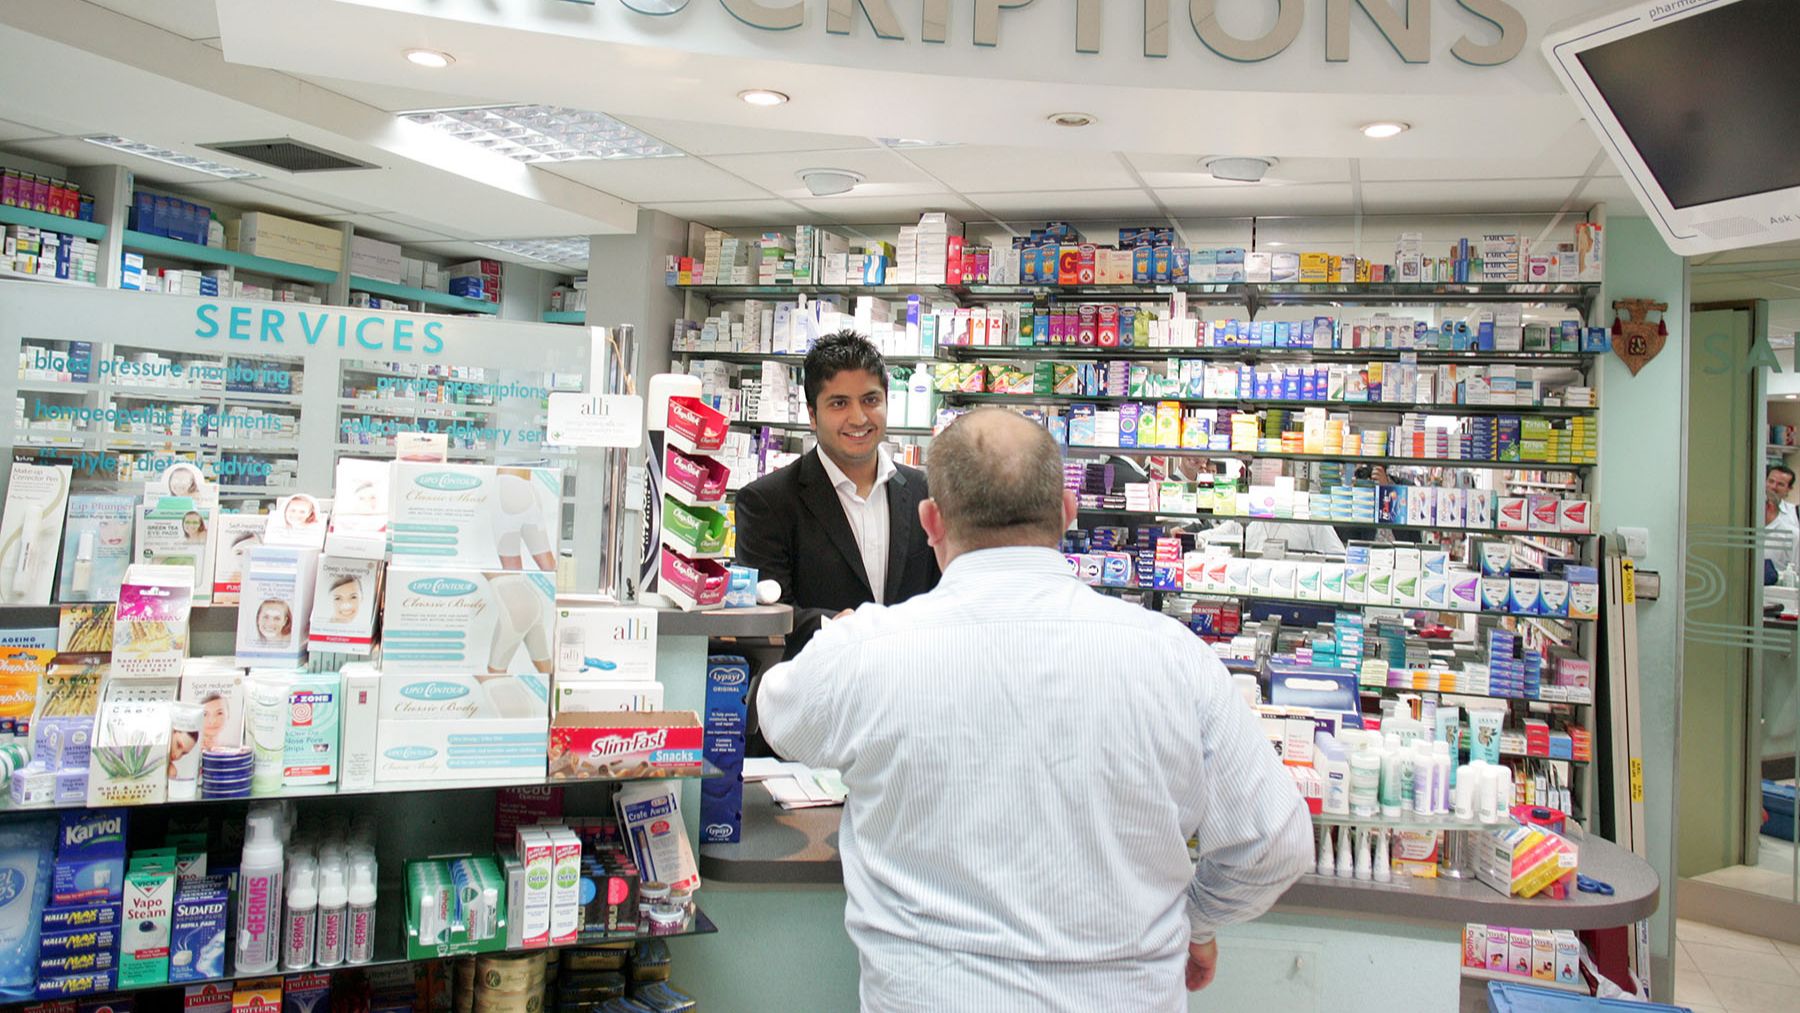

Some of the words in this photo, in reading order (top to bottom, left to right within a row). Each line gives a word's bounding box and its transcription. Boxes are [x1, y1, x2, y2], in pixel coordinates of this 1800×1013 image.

[195, 303, 445, 353] SERVICES
[1702, 331, 1800, 375] SA
[34, 350, 92, 372] blood
[98, 359, 183, 381] pressure
[189, 363, 290, 389] monitoring
[376, 376, 439, 395] private
[444, 377, 549, 399] prescriptions
[34, 400, 174, 427] homoeopathic
[181, 408, 282, 432] treatments
[581, 397, 609, 416] alli
[341, 418, 420, 434] collection
[427, 420, 437, 434] &
[447, 420, 511, 443] delivery
[213, 454, 273, 476] advice
[613, 617, 648, 641] alli
[656, 750, 694, 761] Snacks
[650, 805, 670, 816] Away
[65, 817, 121, 845] Karvol
[133, 898, 163, 909] Vapo
[177, 904, 223, 917] SUDAFED
[44, 913, 70, 922] HALLS
[128, 909, 166, 919] Steam
[43, 937, 69, 946] HALLS
[41, 958, 67, 968] HALLS
[39, 980, 65, 990] HALLS
